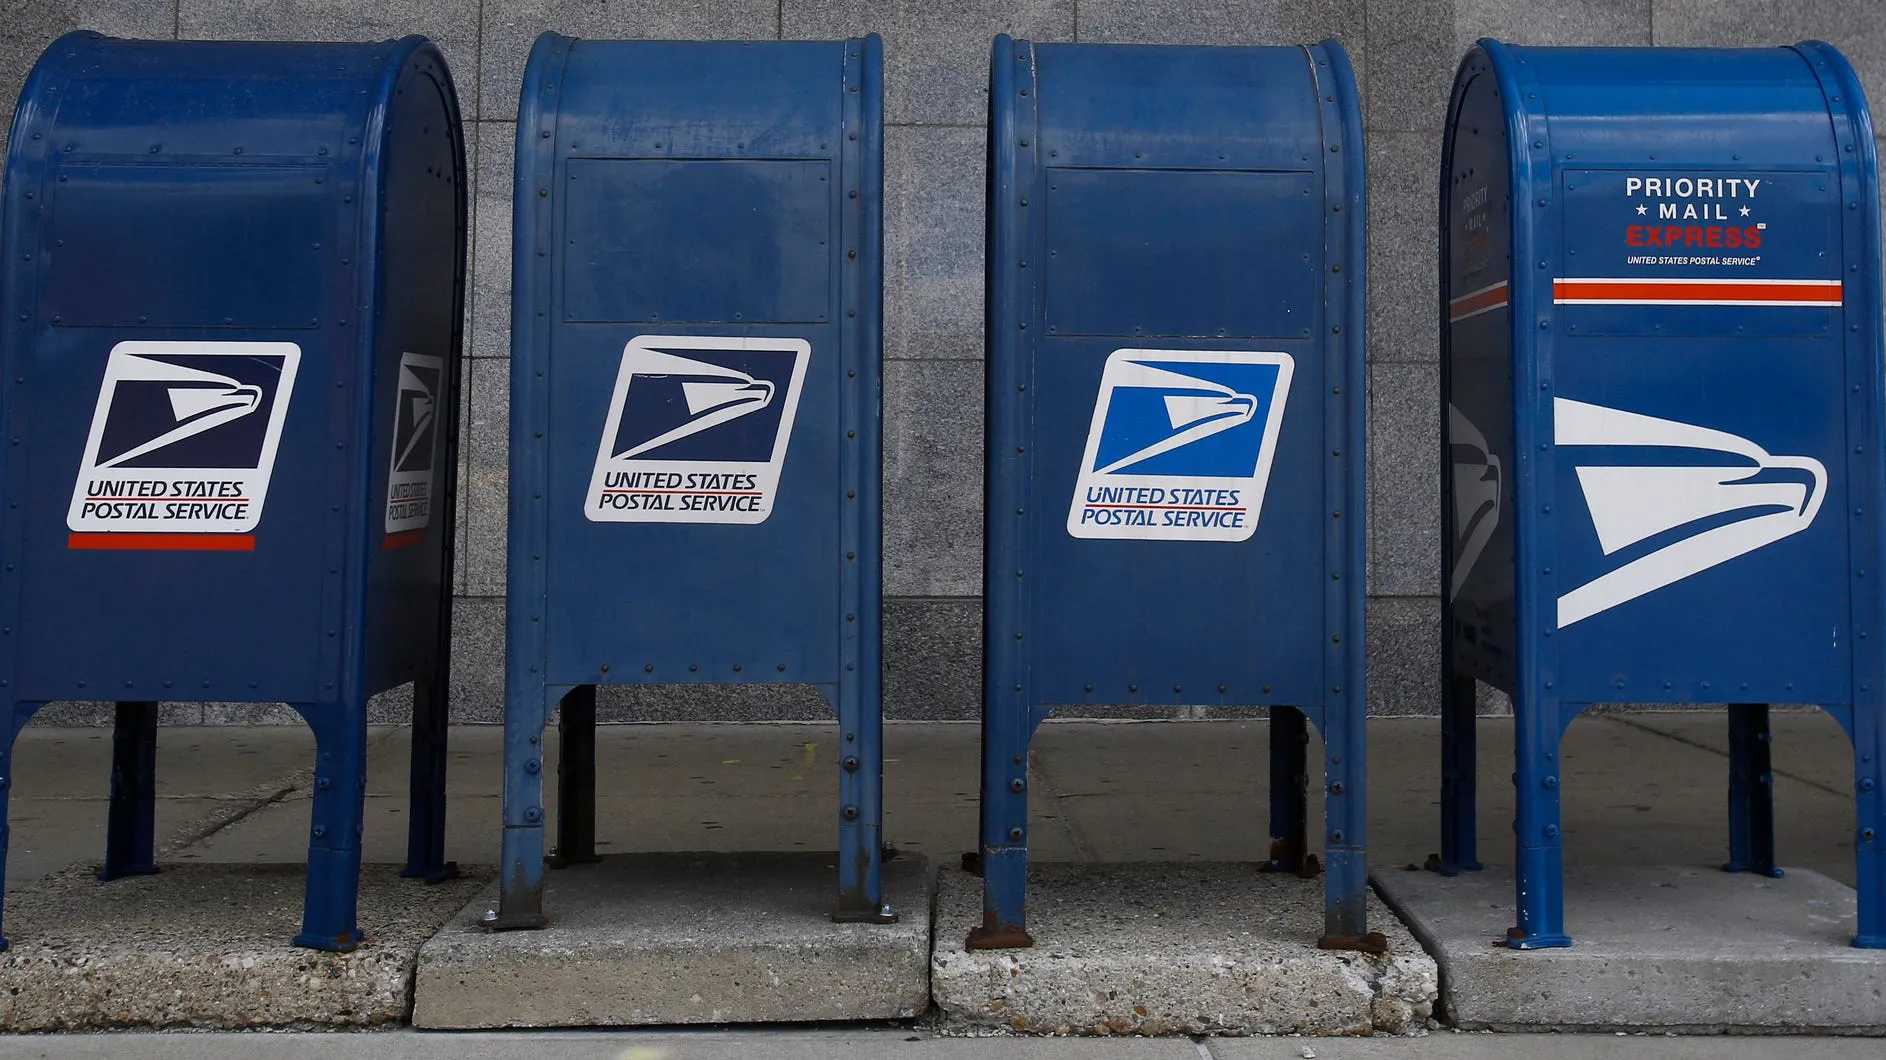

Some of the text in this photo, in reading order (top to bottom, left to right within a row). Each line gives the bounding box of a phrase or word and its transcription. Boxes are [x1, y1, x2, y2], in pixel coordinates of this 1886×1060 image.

[1626, 177, 1761, 198] PRIORITY
[1659, 203, 1728, 220] MAIL
[1626, 225, 1762, 249] EXPRESS
[1627, 256, 1657, 265] UNITED
[1658, 256, 1688, 265] STATES
[1689, 256, 1721, 265] POSTAL
[87, 480, 244, 498] UNITED STATES
[605, 471, 757, 490] UNITED STATES
[390, 483, 410, 499] UNITED
[1086, 486, 1241, 506] UNITED STATES
[81, 503, 159, 519] POSTAL
[599, 494, 675, 511] POSTAL
[1081, 508, 1157, 527] POSTAL
